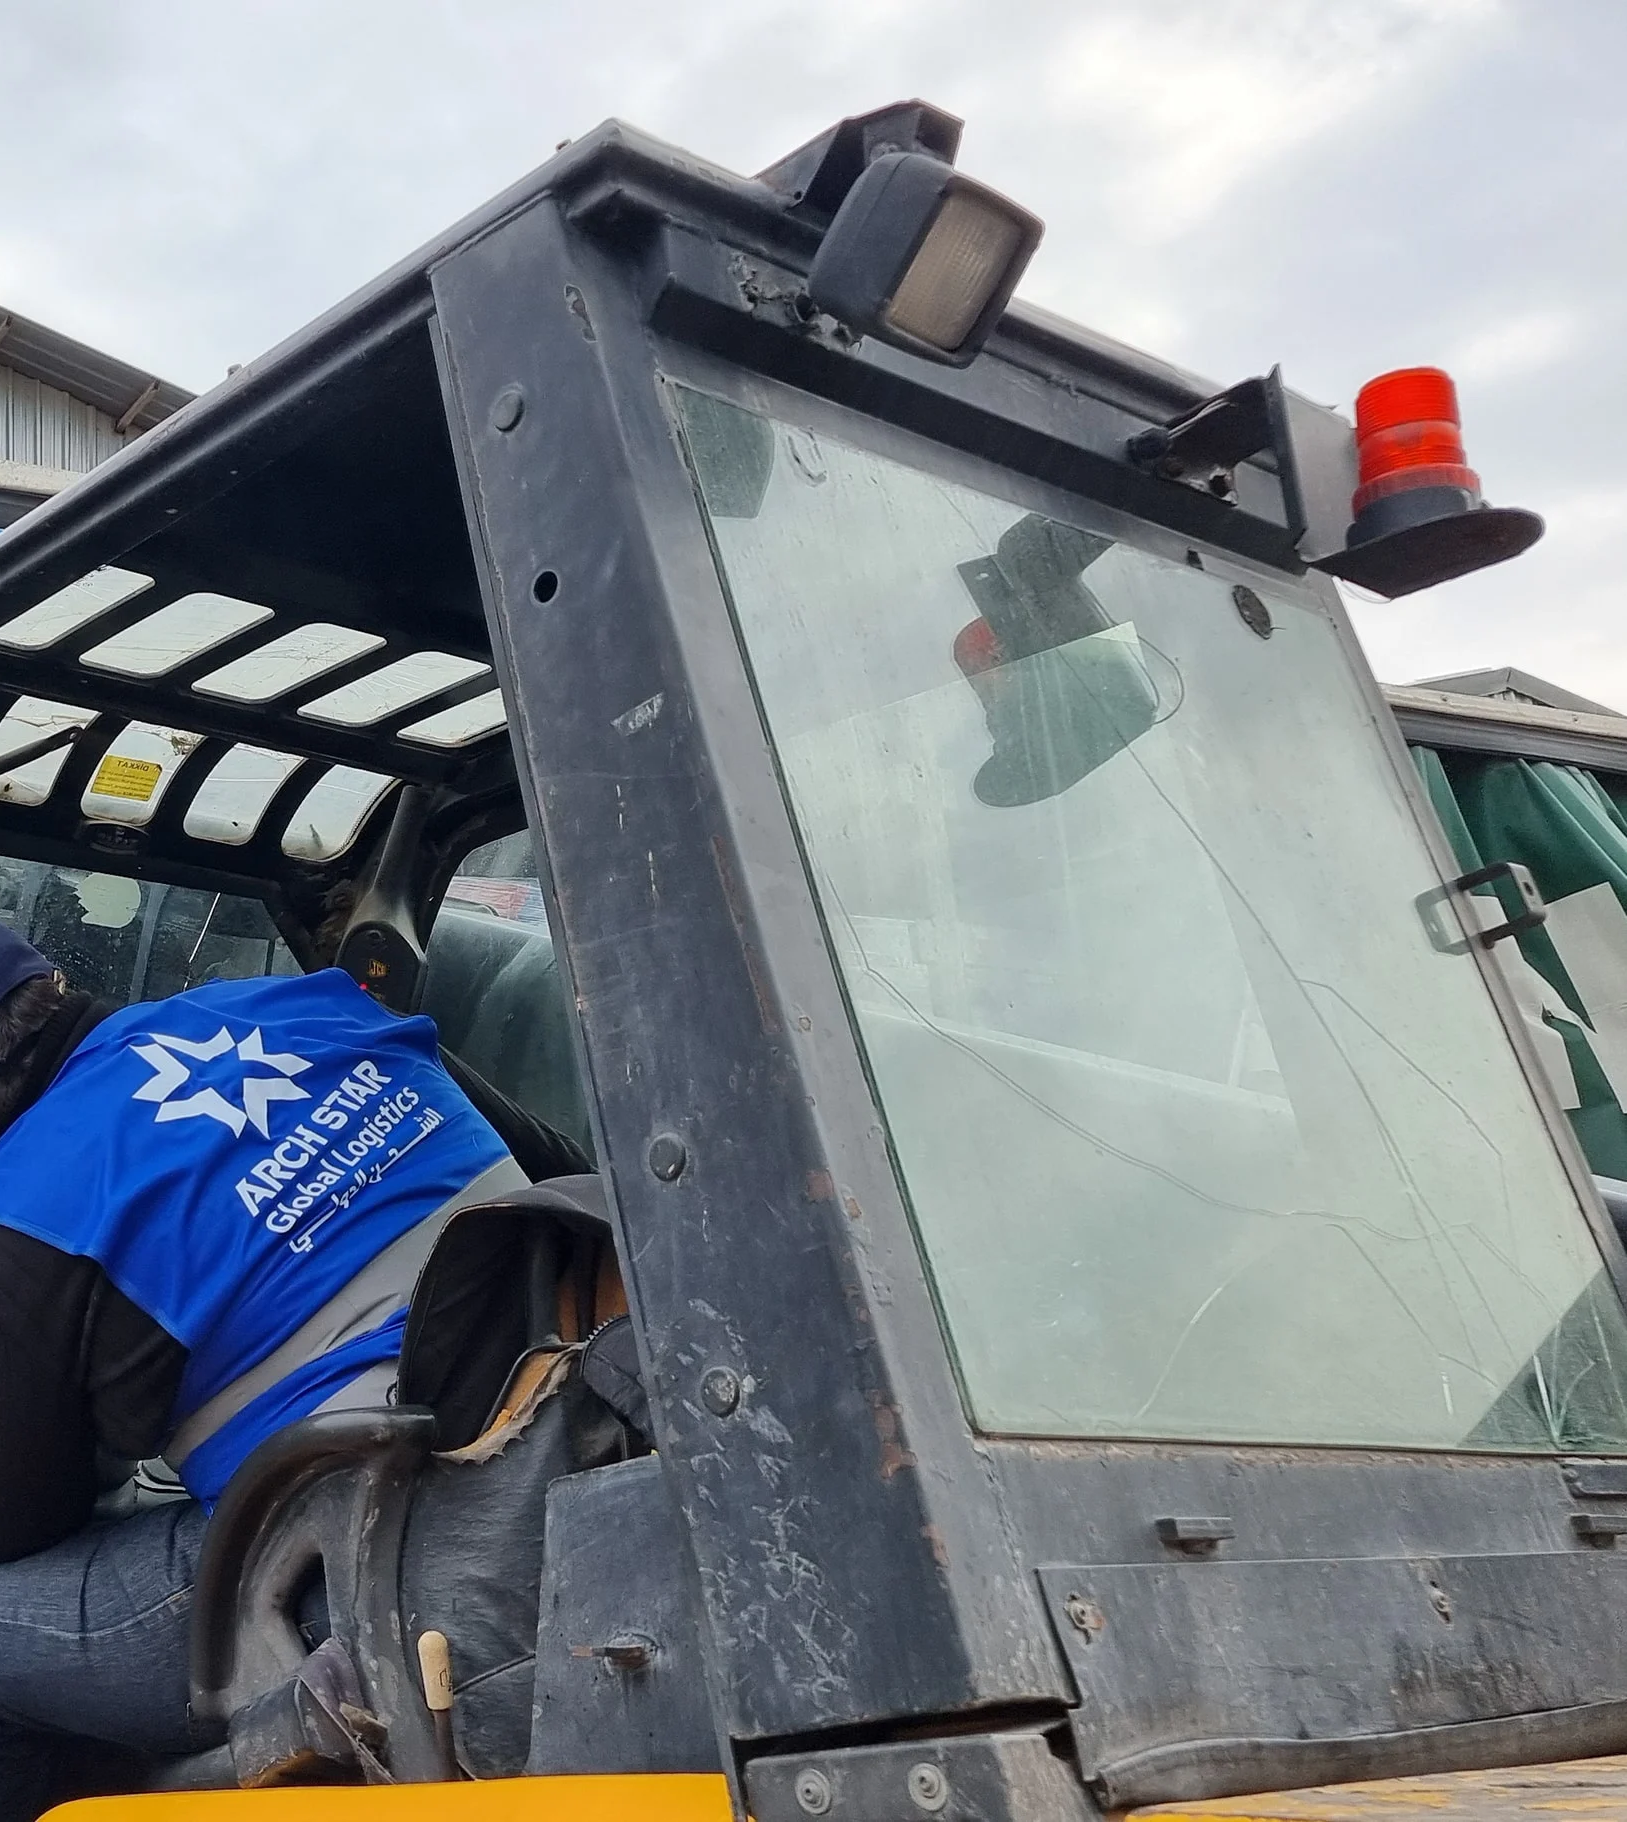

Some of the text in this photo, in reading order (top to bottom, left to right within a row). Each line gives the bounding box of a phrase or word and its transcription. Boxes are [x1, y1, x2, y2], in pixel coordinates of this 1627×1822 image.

[234, 1059, 393, 1218] ARCH STAR
[265, 1086, 421, 1234] Global Logistics
